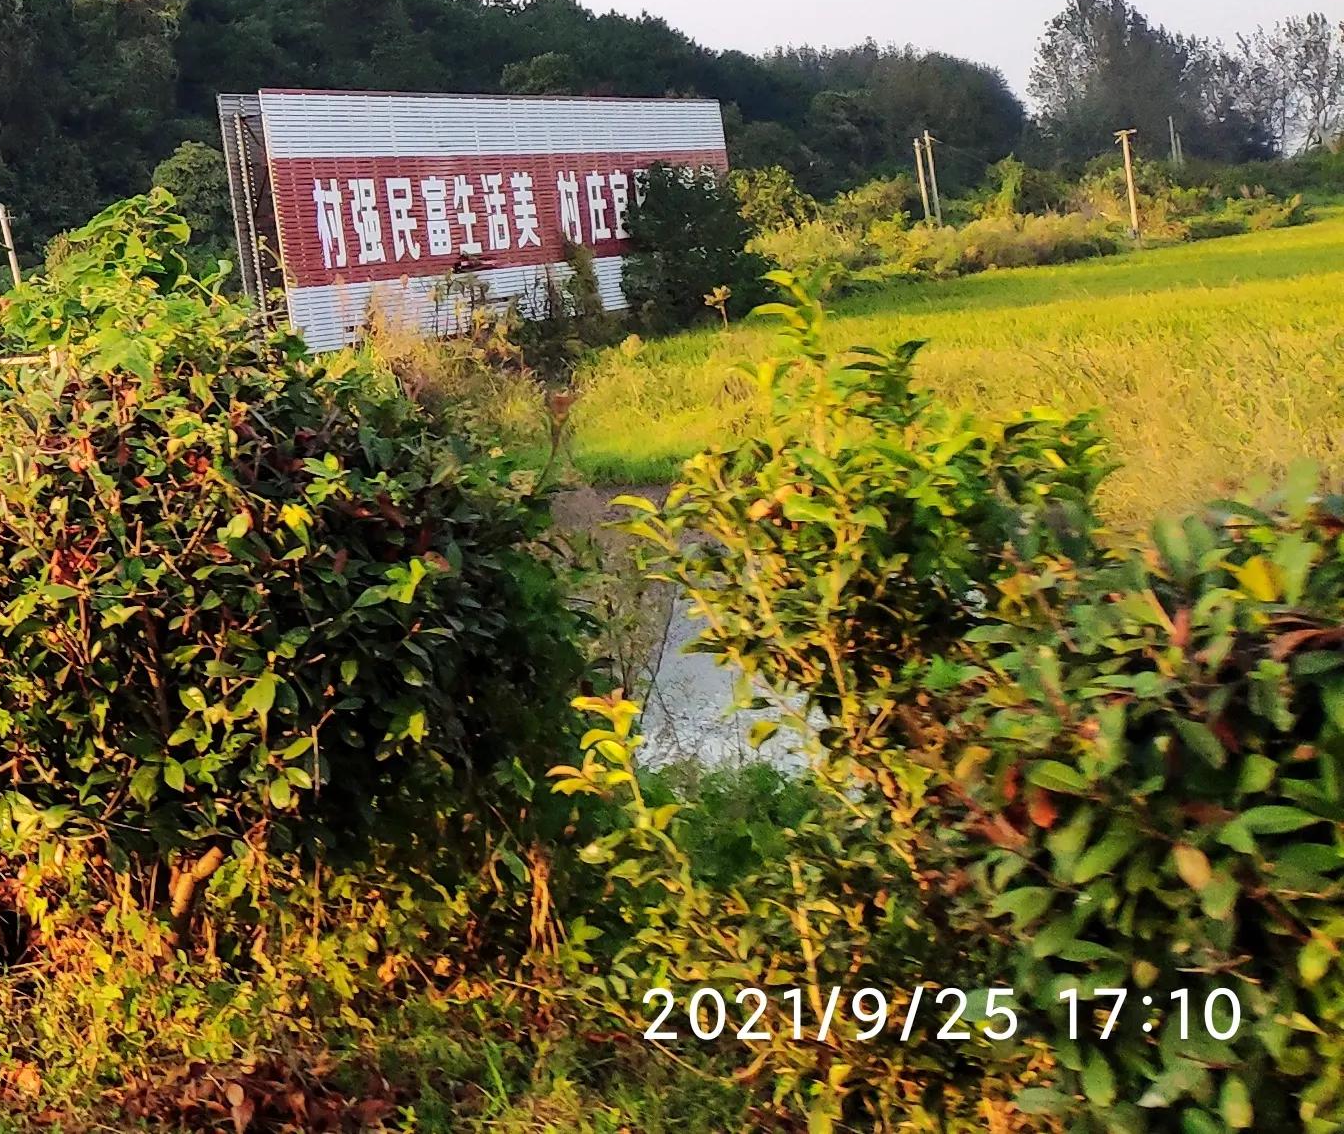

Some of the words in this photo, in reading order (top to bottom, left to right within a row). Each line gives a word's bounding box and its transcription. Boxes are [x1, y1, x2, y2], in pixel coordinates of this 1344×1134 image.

[313, 171, 542, 269] 村强民富生活美
